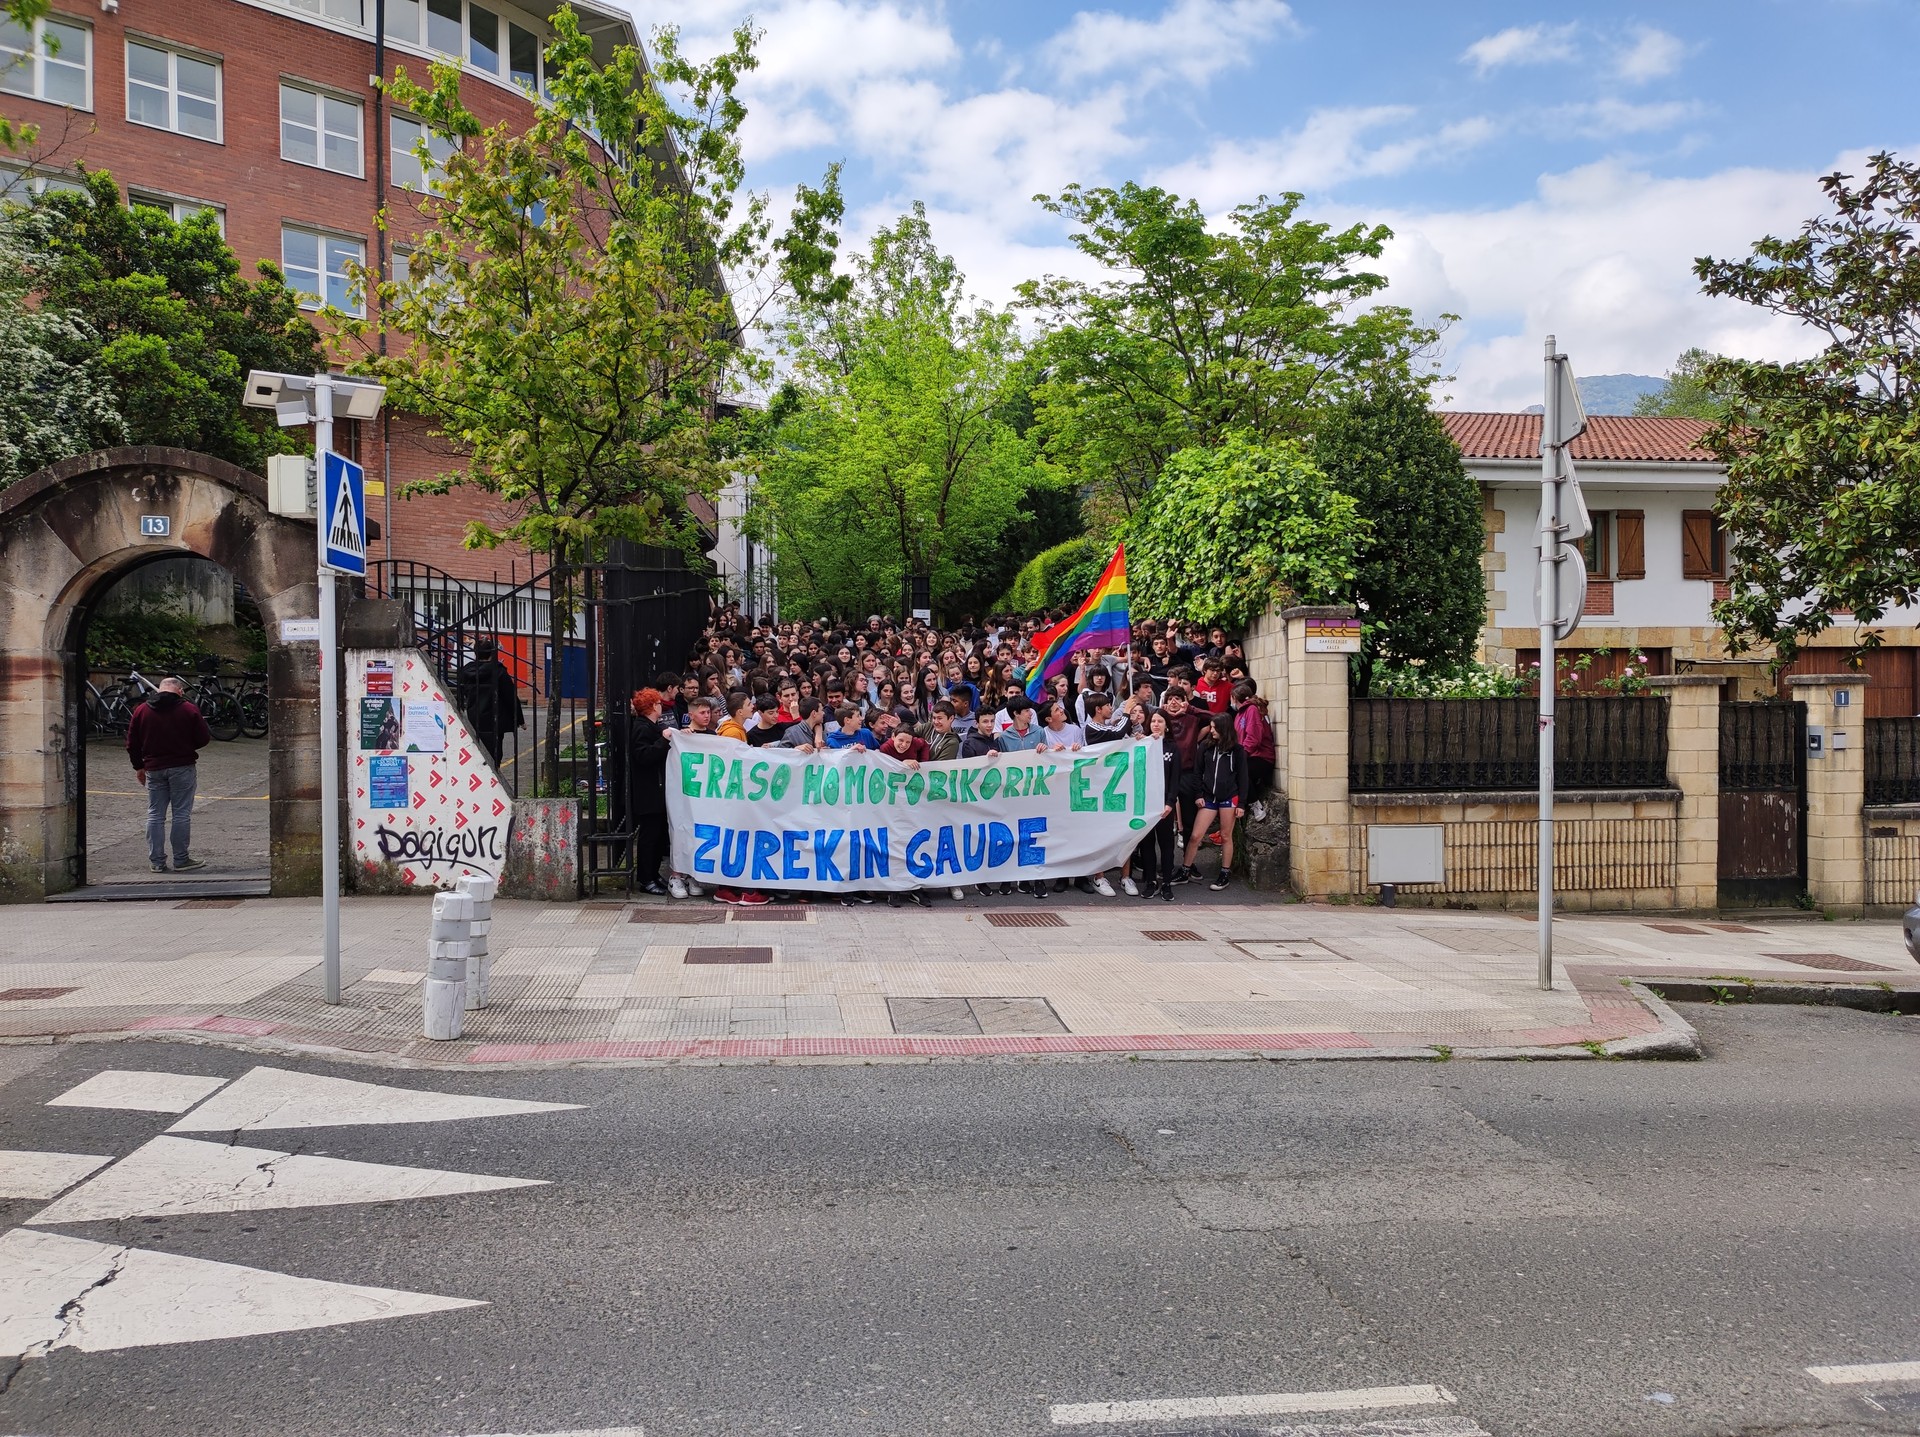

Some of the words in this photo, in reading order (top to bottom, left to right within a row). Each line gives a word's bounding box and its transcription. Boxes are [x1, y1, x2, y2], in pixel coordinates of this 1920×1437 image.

[146, 518, 165, 533] 13
[1840, 692, 1845, 704] 1
[680, 751, 792, 802] ERASO
[801, 764, 1058, 806] HOMOFOBIKORIK
[1069, 745, 1148, 831] EZ!
[693, 823, 890, 882] ZUREKIN
[905, 816, 1048, 879] GAUDE
